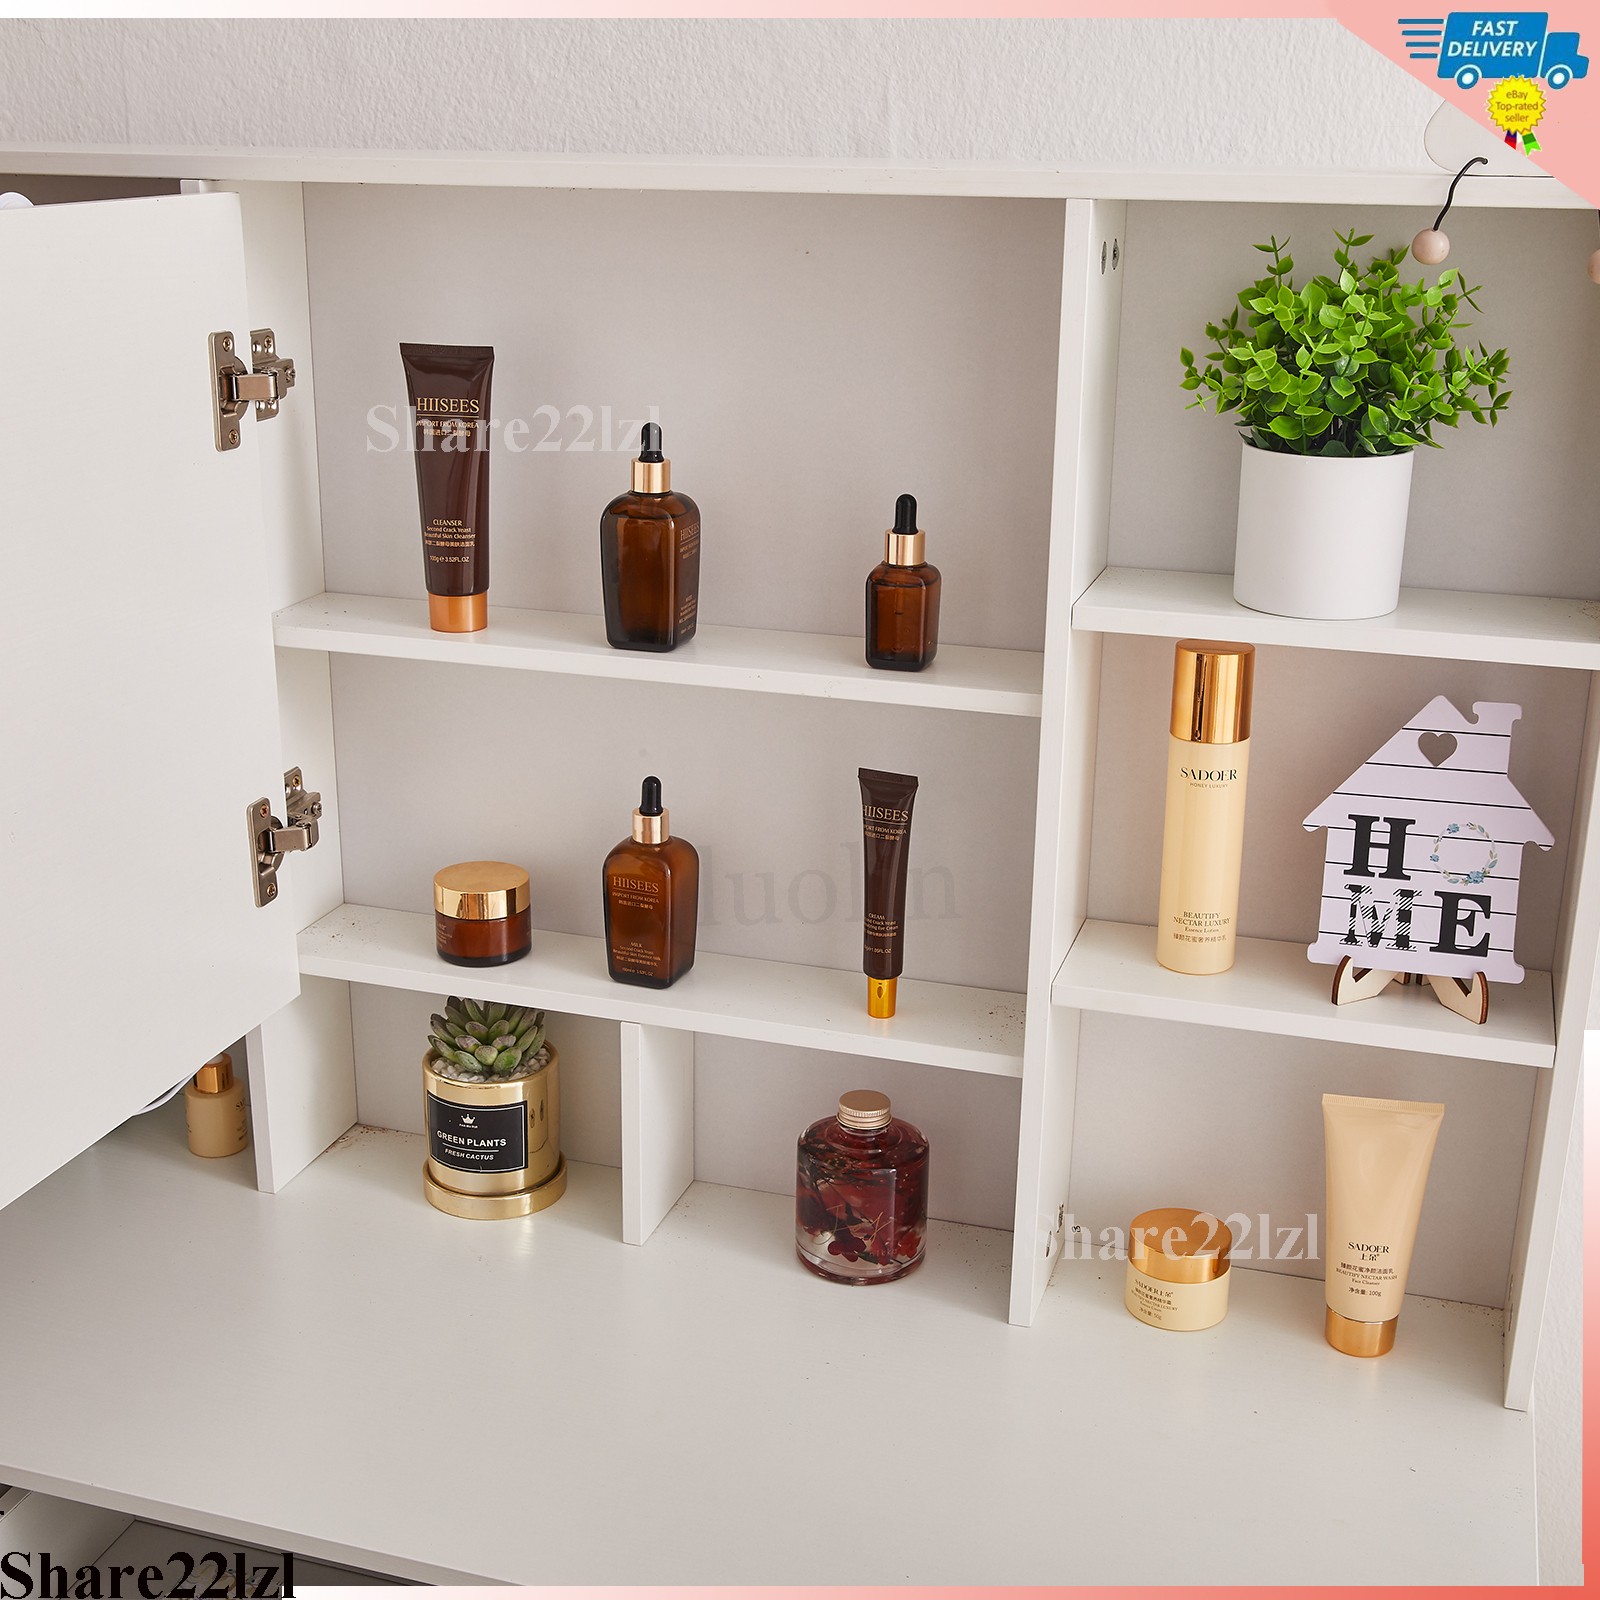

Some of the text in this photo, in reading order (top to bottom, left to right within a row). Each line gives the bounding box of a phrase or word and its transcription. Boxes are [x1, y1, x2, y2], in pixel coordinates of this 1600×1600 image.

[416, 397, 480, 414] HIISEES
[432, 518, 462, 526] CLEANSER
[1180, 766, 1238, 781] SADOER
[613, 876, 659, 894] HIISEES
[1173, 916, 1230, 926] NECTAR LUXURY
[1183, 911, 1221, 920] BEAUTIFY
[436, 1130, 507, 1147] GREEN PLANTS
[444, 1148, 465, 1158] FRESH
[1348, 1242, 1390, 1254] SADOER
